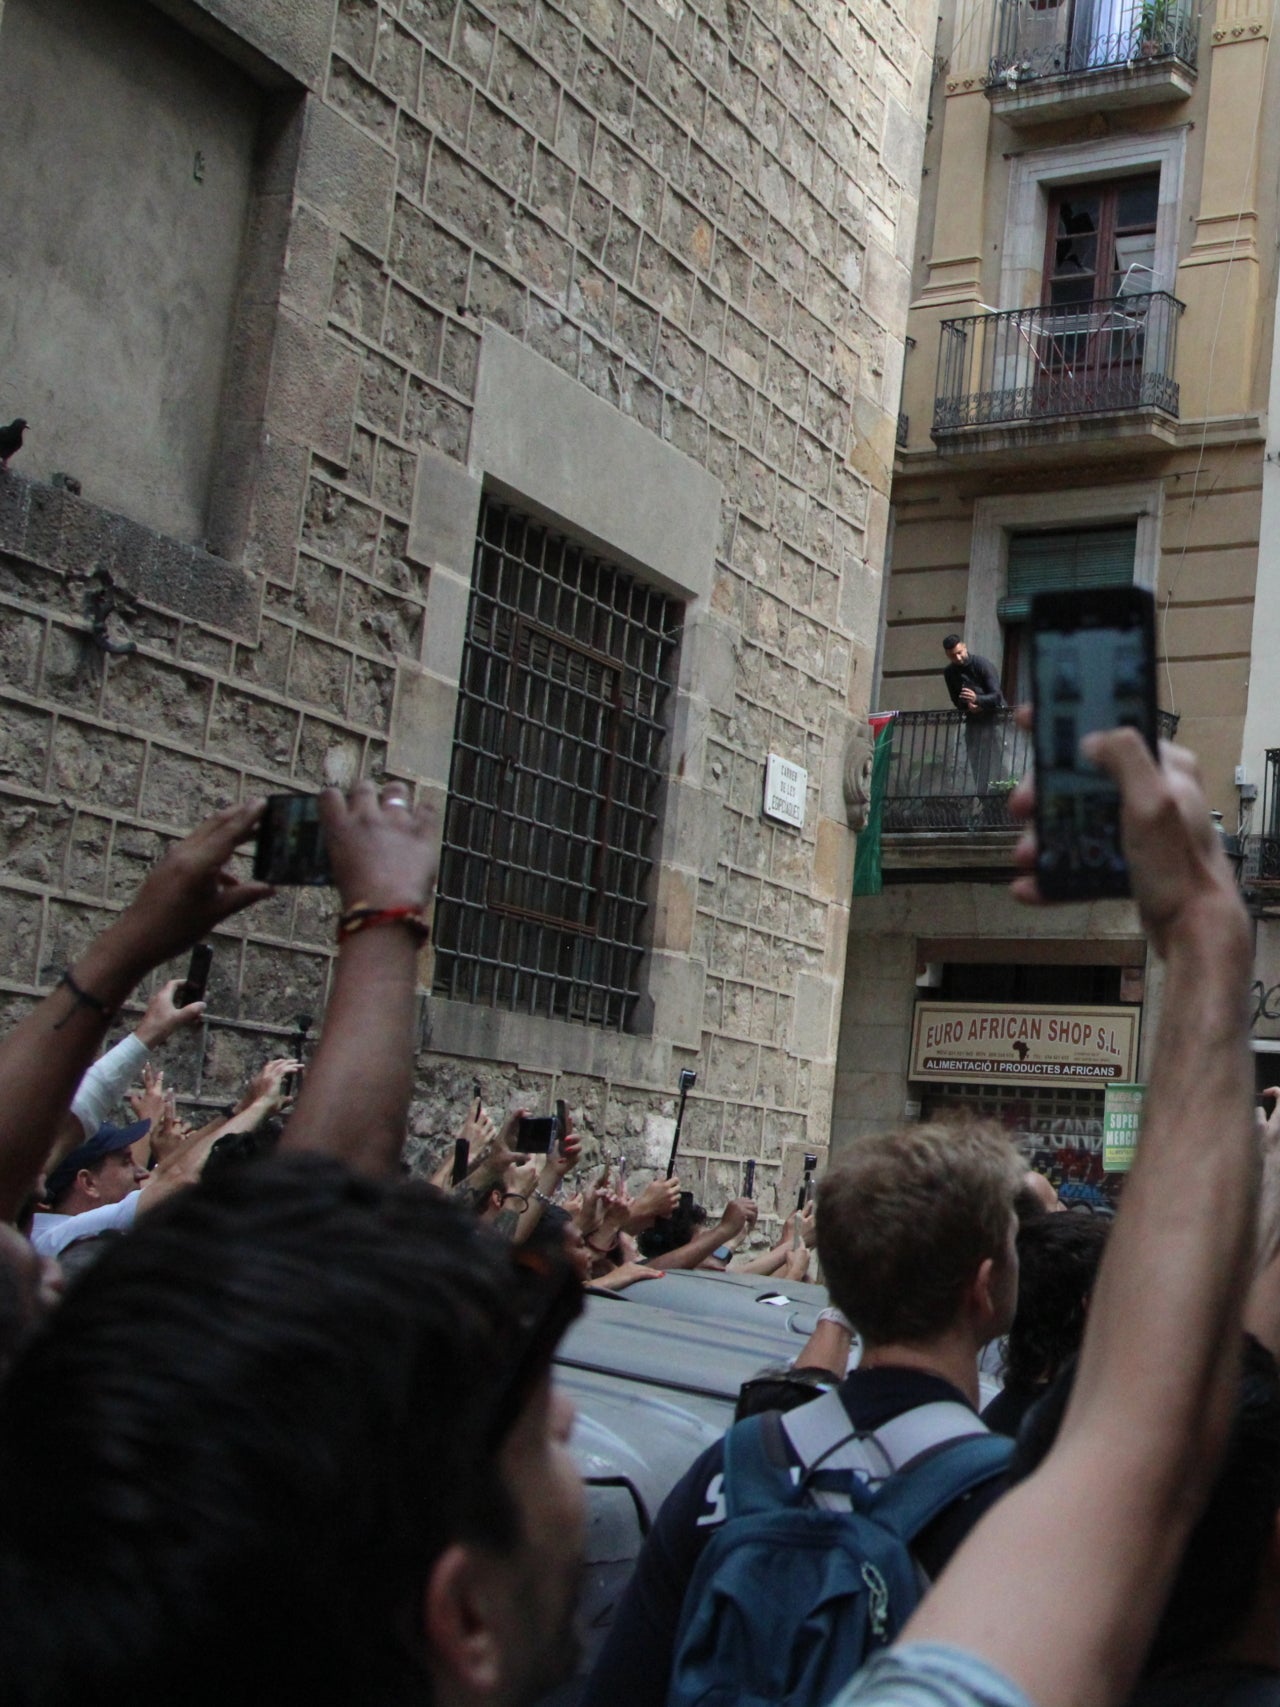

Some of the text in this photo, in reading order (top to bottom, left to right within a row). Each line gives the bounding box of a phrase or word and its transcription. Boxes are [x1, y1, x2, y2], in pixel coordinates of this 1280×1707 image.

[926, 1016, 1120, 1056] EURO AFRICAN SHOP S.L.
[926, 1059, 1115, 1076] ALIMENTACIÓ I PRODUCTES AFRICANS
[1110, 1113, 1139, 1129] SUPER
[1106, 1130, 1138, 1146] MERCA
